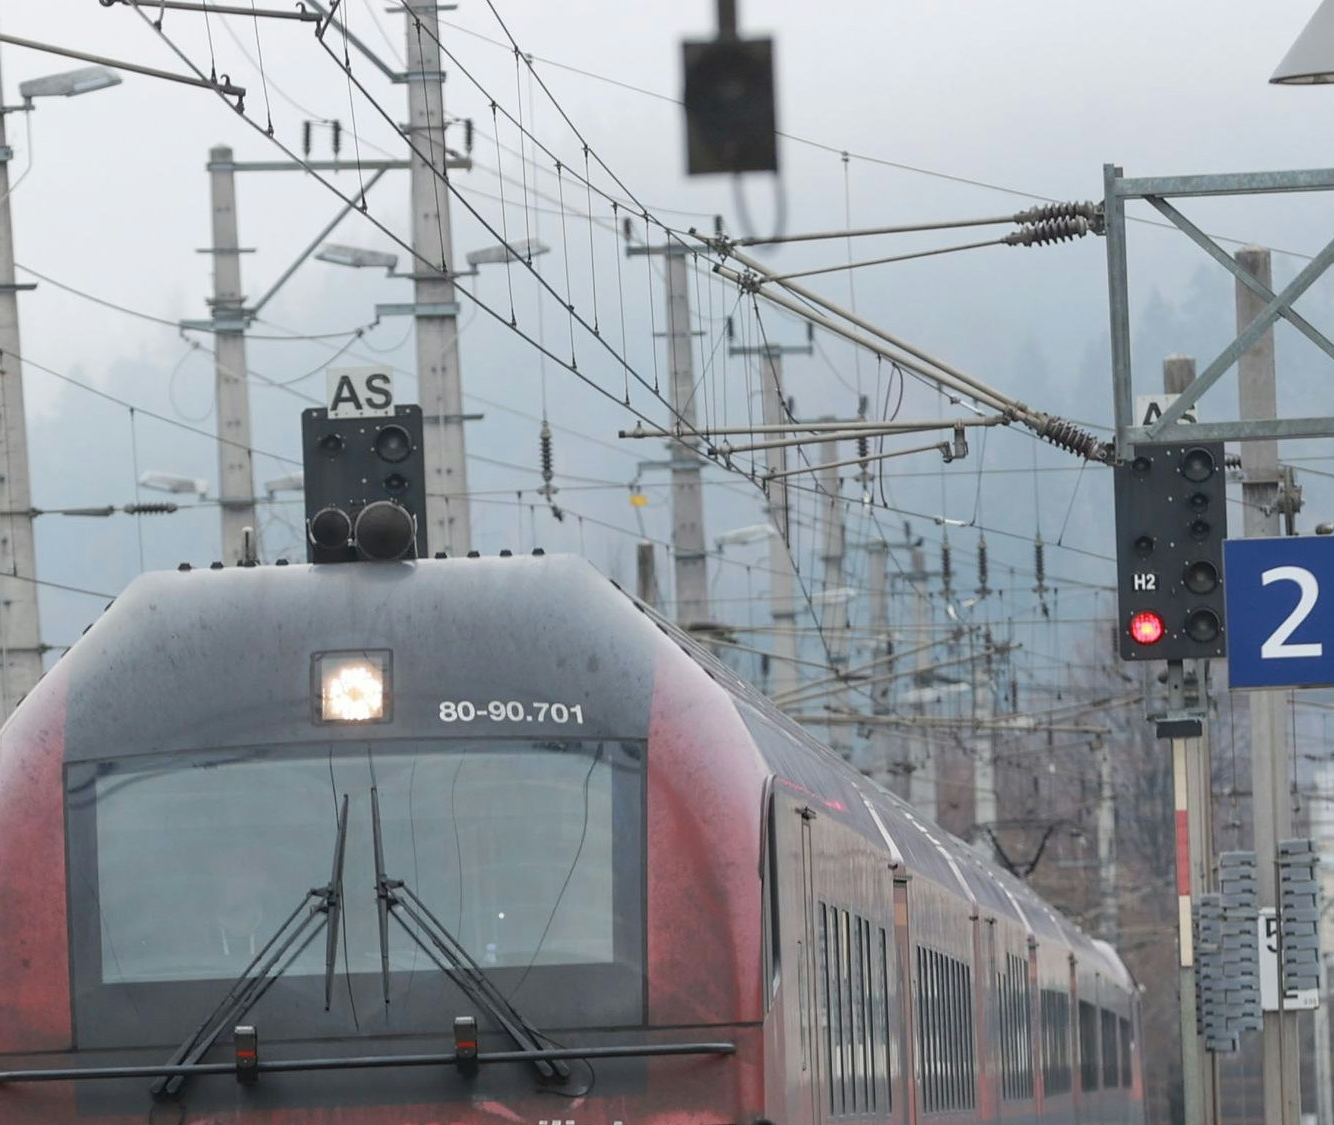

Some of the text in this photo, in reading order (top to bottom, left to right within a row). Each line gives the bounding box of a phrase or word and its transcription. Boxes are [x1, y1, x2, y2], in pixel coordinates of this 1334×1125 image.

[330, 373, 393, 412] AS
[1133, 573, 1157, 591] H2
[1260, 565, 1323, 660] 2
[438, 700, 584, 724] 80-90.701
